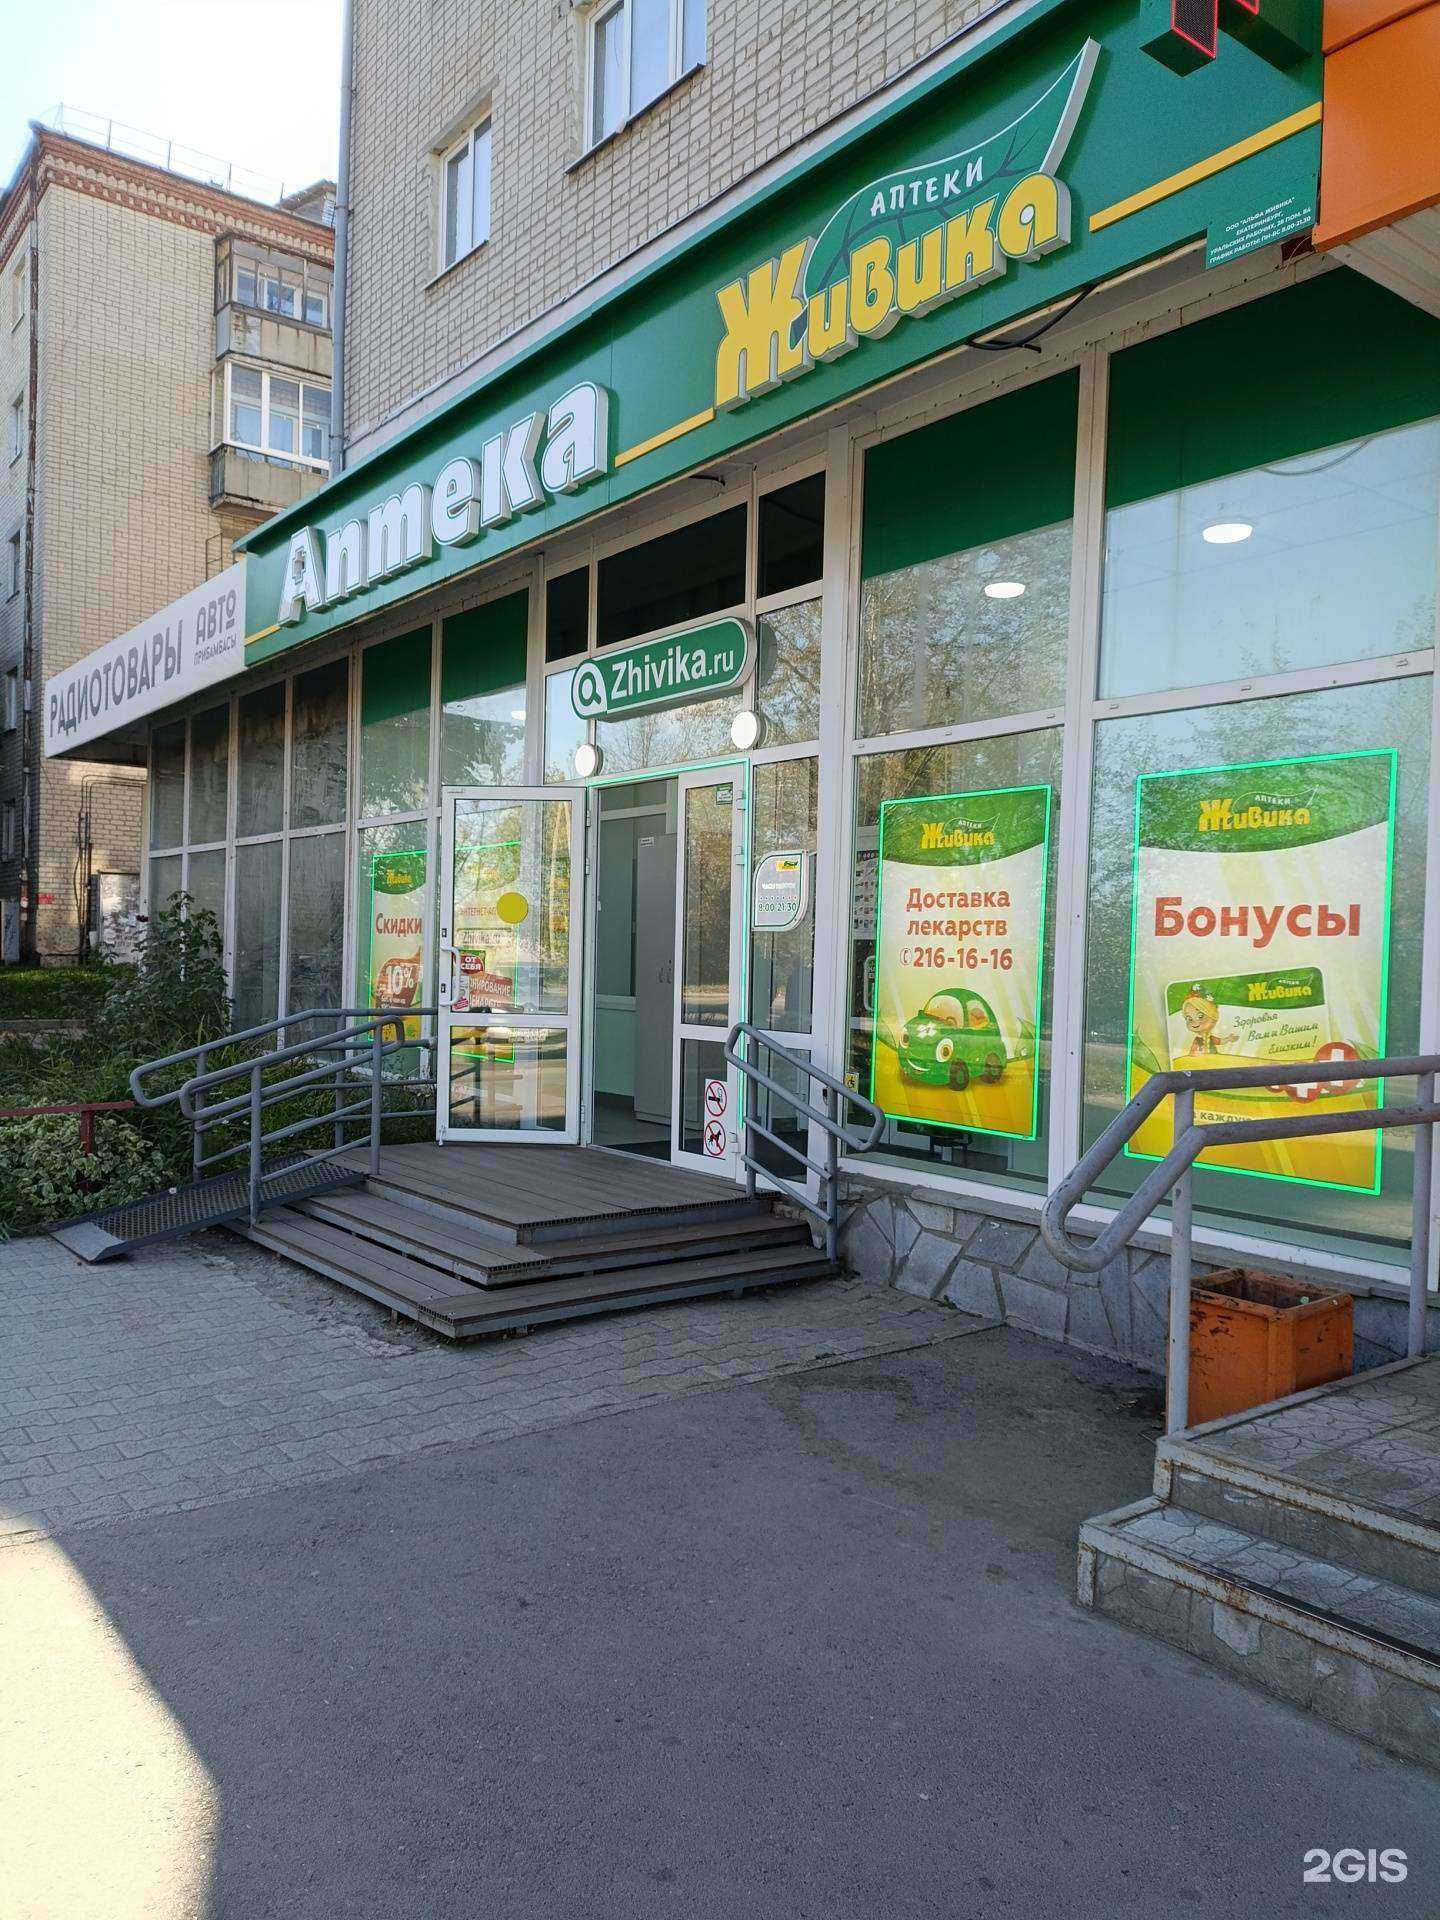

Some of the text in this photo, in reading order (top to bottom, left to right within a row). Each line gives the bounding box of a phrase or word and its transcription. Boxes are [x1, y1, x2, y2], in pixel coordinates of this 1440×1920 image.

[871, 157, 983, 216] АПТЕКИ
[1226, 222, 1239, 231] ООО
[714, 172, 1071, 412] Живика
[278, 381, 608, 627] Аптека
[195, 589, 236, 645] АВТО
[193, 634, 237, 665] ПРИБАМБАСЫ
[50, 619, 184, 738] РАДИОТОВАРЫ
[611, 645, 734, 700] Zhivika.ru
[1198, 799, 1310, 832] Живика
[921, 823, 995, 849] Живика
[906, 888, 1010, 912] Доставка
[375, 912, 422, 938] Скидки
[906, 919, 1008, 941] лекарств
[1155, 896, 1361, 949] Бонусы
[460, 963, 481, 971] СЕБЯ
[913, 947, 1013, 970] 216-16-16
[1233, 1012, 1278, 1030] Здоровья
[1247, 1029, 1270, 1041] Вам
[1279, 1022, 1319, 1037] Вашим
